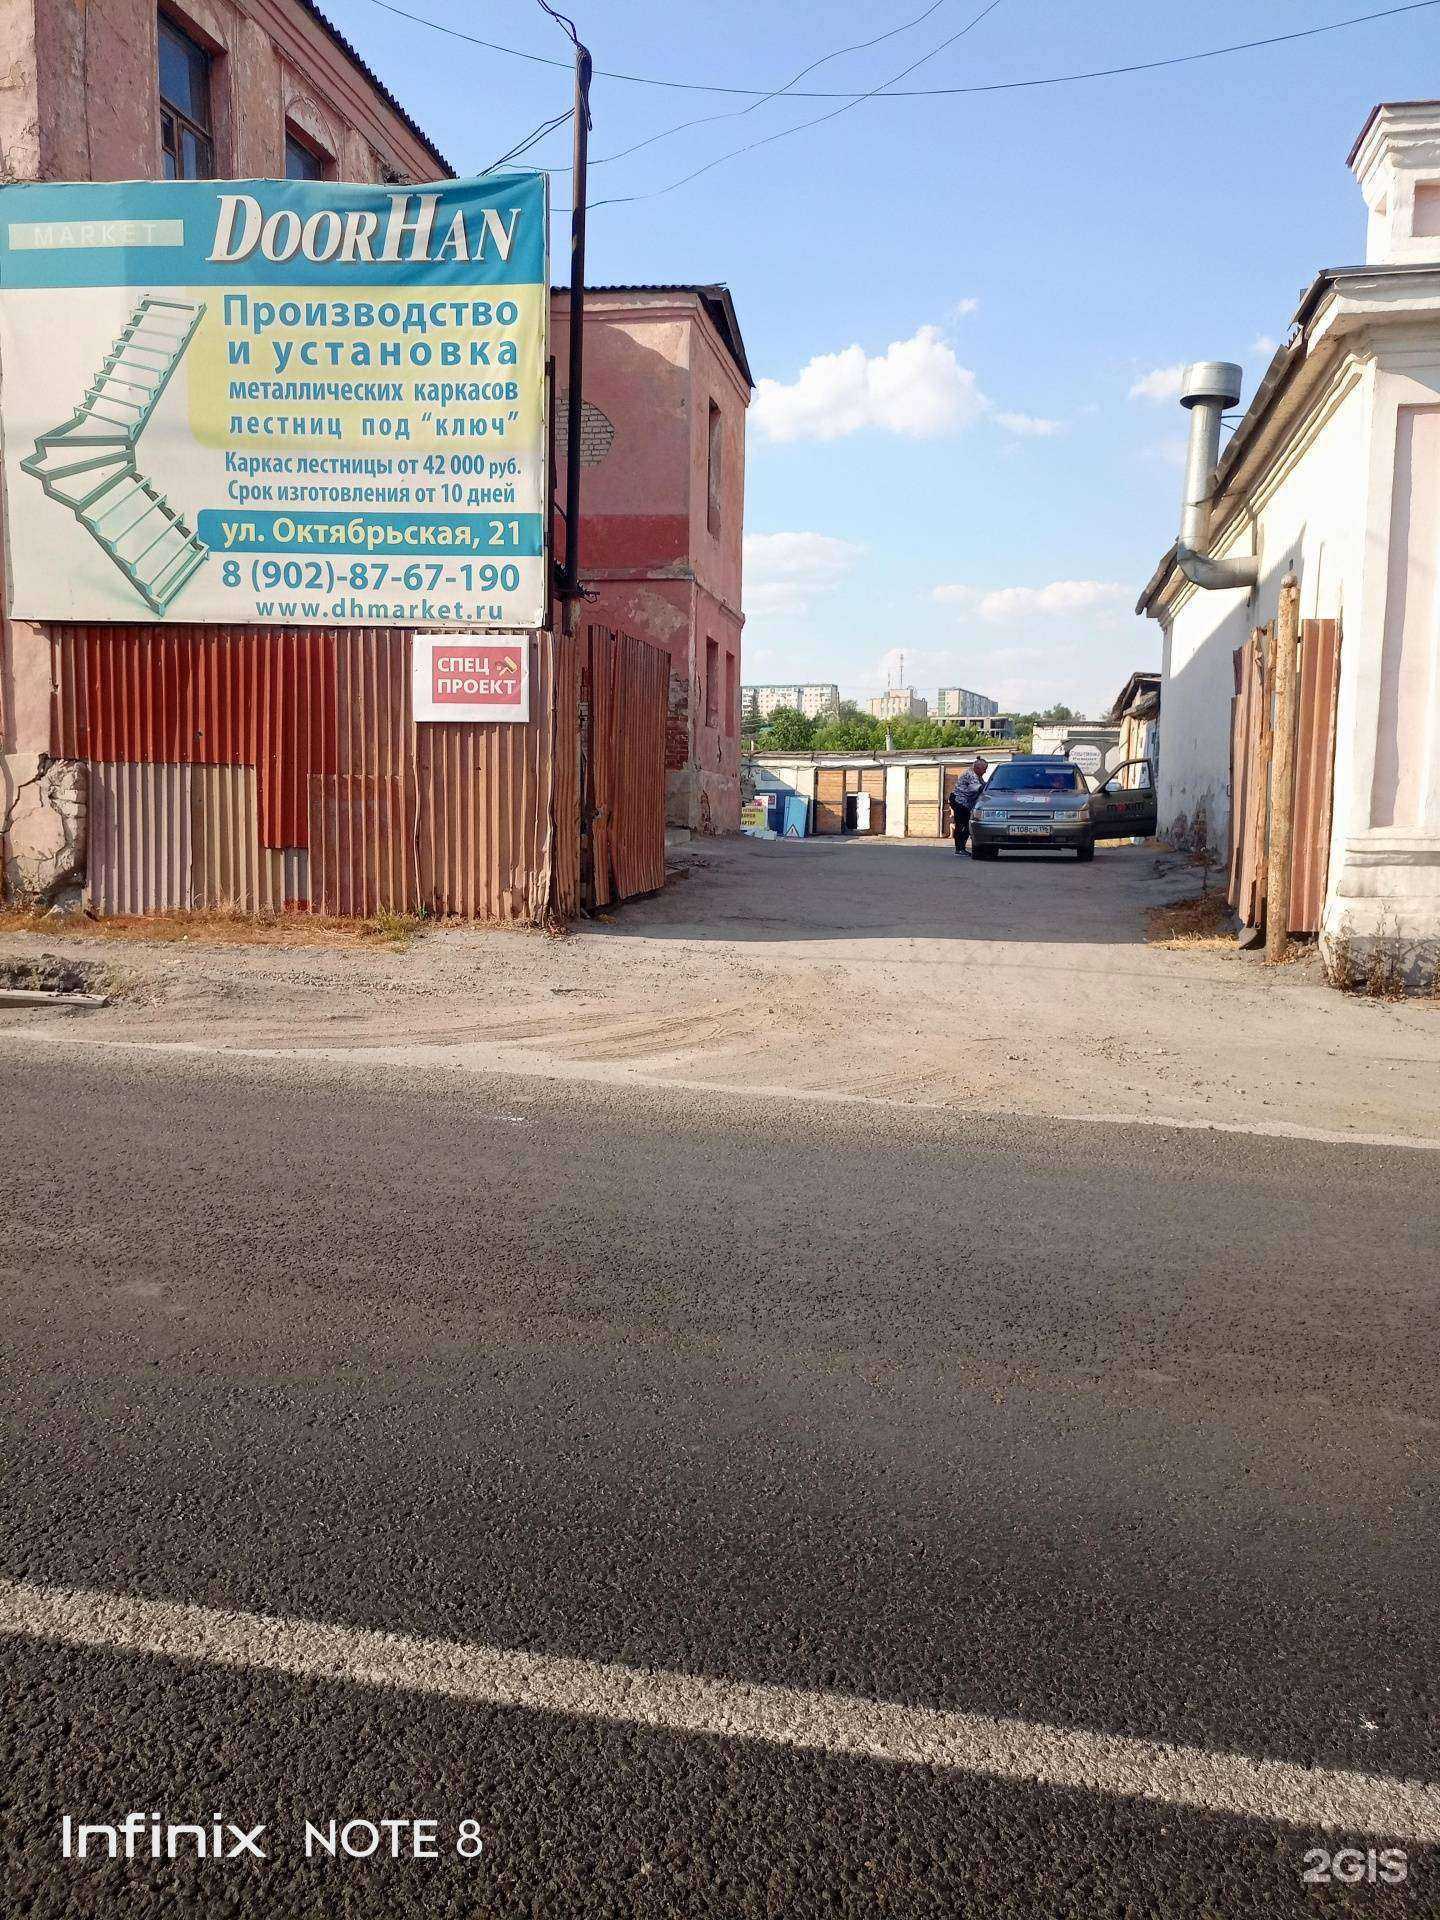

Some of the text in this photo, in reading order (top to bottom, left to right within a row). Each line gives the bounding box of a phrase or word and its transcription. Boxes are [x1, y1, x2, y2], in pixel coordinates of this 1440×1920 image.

[33, 223, 157, 248] MARKET
[222, 293, 519, 335] Производство
[228, 340, 518, 375] и установка
[229, 381, 519, 407] металлических каркасов
[229, 415, 343, 440] лестниц
[361, 417, 411, 441] под
[225, 451, 522, 479] Каркас лестницы от 42 000 руб.
[228, 479, 516, 506] Срок изготовления от 10 дней
[221, 517, 520, 550] ул. Октябрьская, 21
[222, 560, 520, 593] 8 (902)-87-67-190
[255, 597, 503, 620] www.dhmarket.ru
[437, 657, 490, 676] СПЕЦ
[437, 678, 517, 695] ПРОЕКТ
